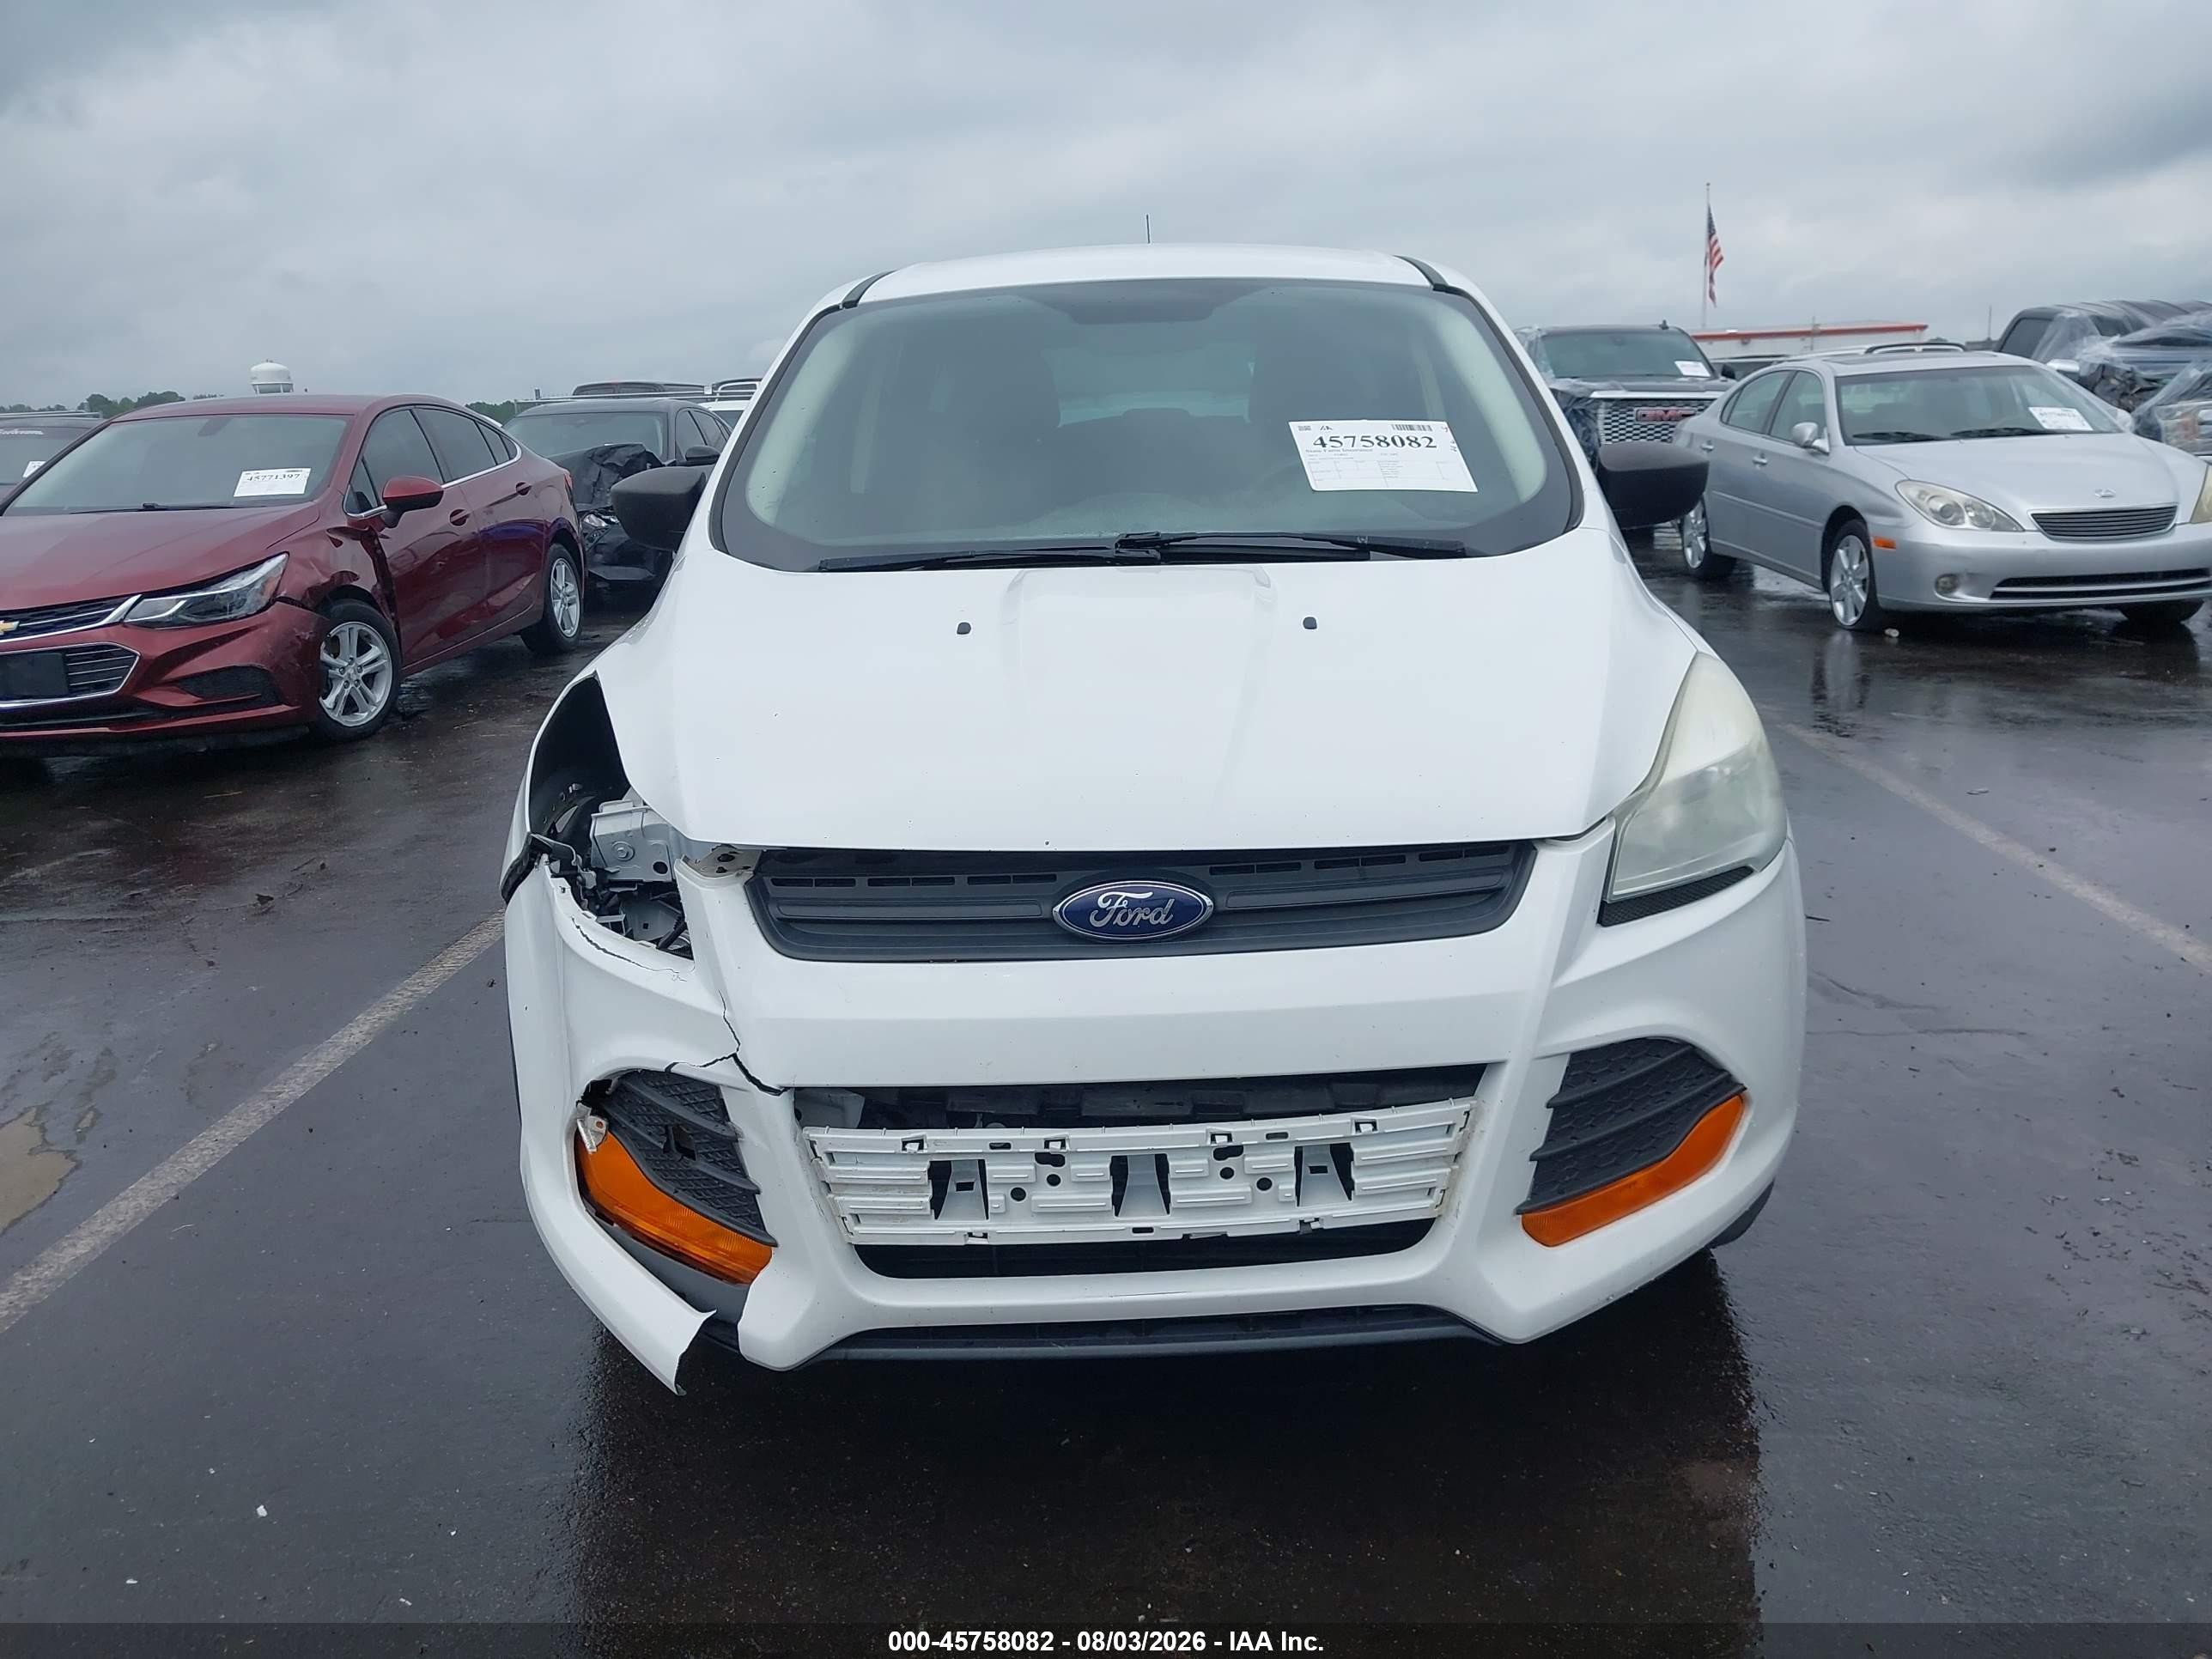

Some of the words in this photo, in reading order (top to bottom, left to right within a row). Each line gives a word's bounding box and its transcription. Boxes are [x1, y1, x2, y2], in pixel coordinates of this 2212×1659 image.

[1638, 410, 1696, 422] GMC
[1313, 434, 1437, 449] 45758082
[1089, 891, 1176, 927] Ford
